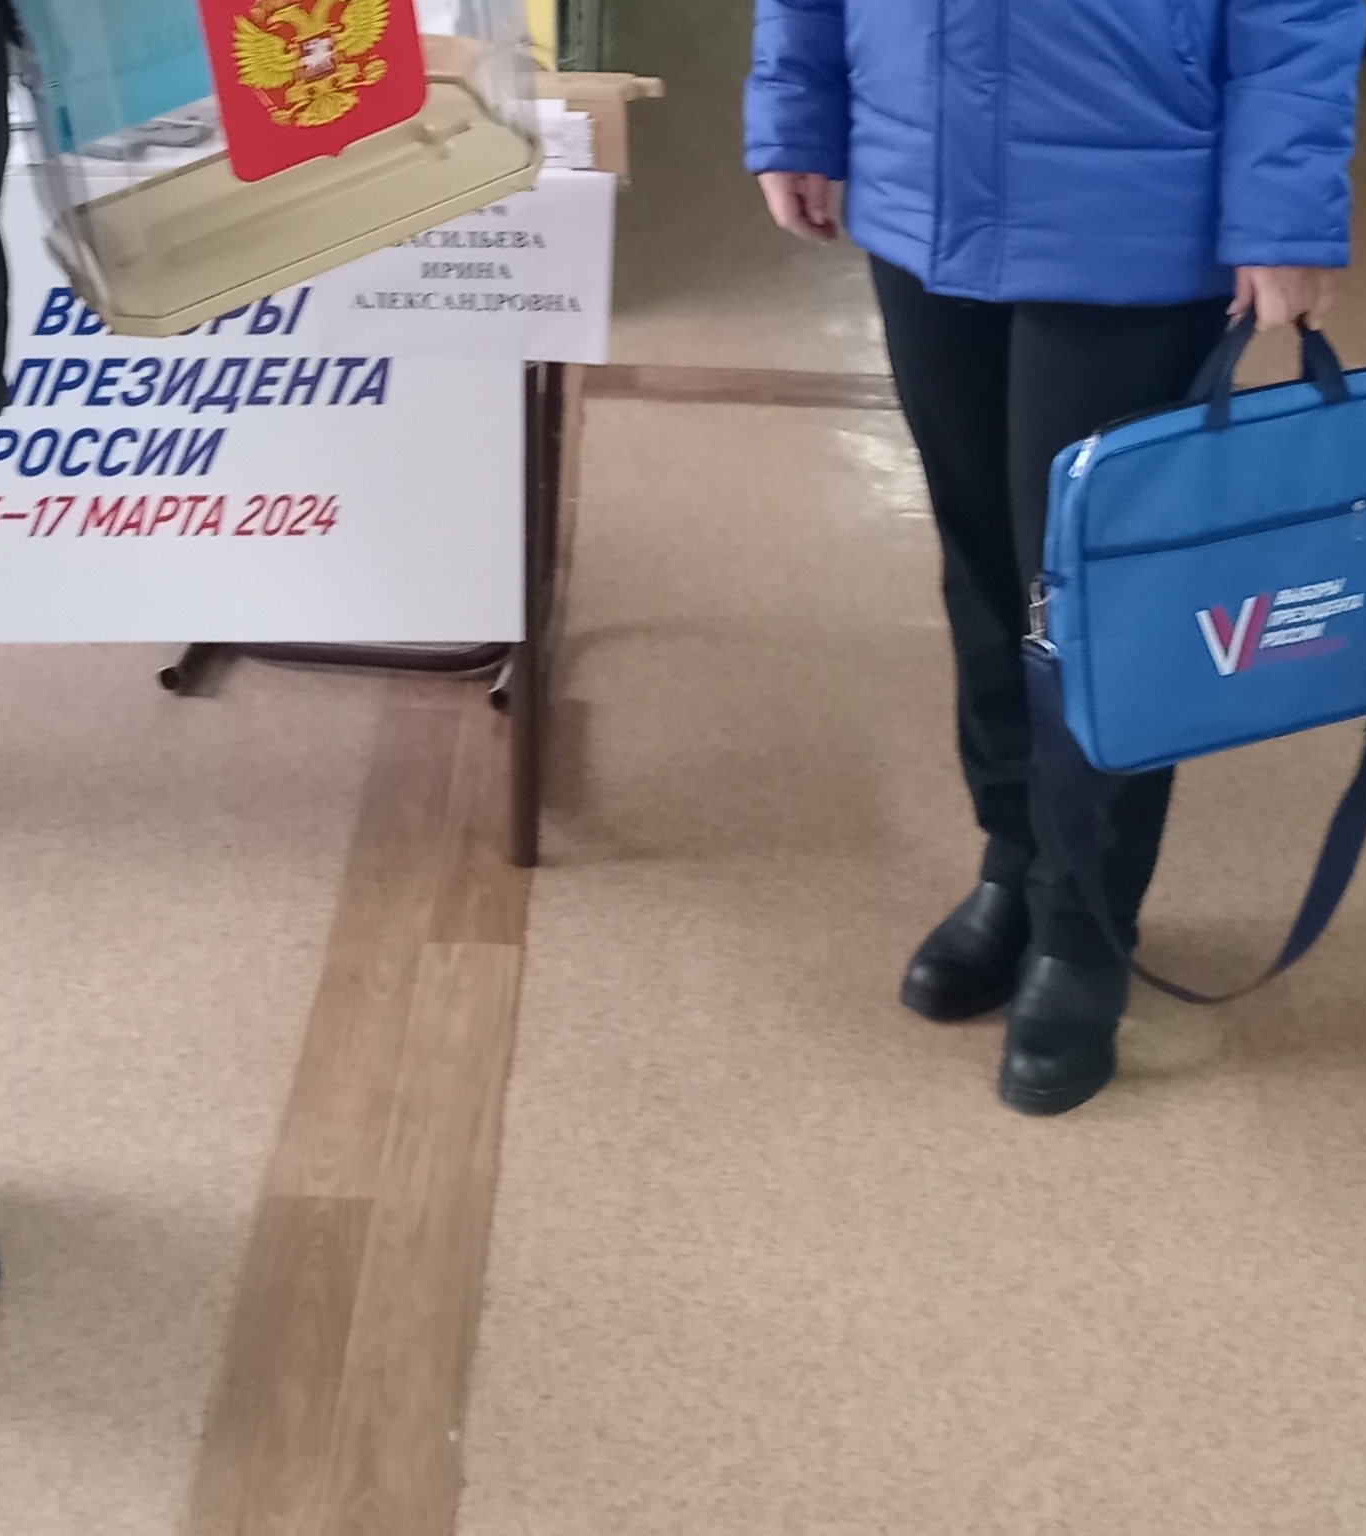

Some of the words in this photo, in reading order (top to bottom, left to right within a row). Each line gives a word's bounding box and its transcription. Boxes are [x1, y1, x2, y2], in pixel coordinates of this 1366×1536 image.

[420, 261, 512, 280] ИРИНА
[349, 291, 582, 313] АЛЕКСАНДРОВНА
[6, 356, 393, 415] ПРЕЗИДЕНТА
[76, 494, 229, 538] МАРТА
[232, 492, 342, 538] 2024
